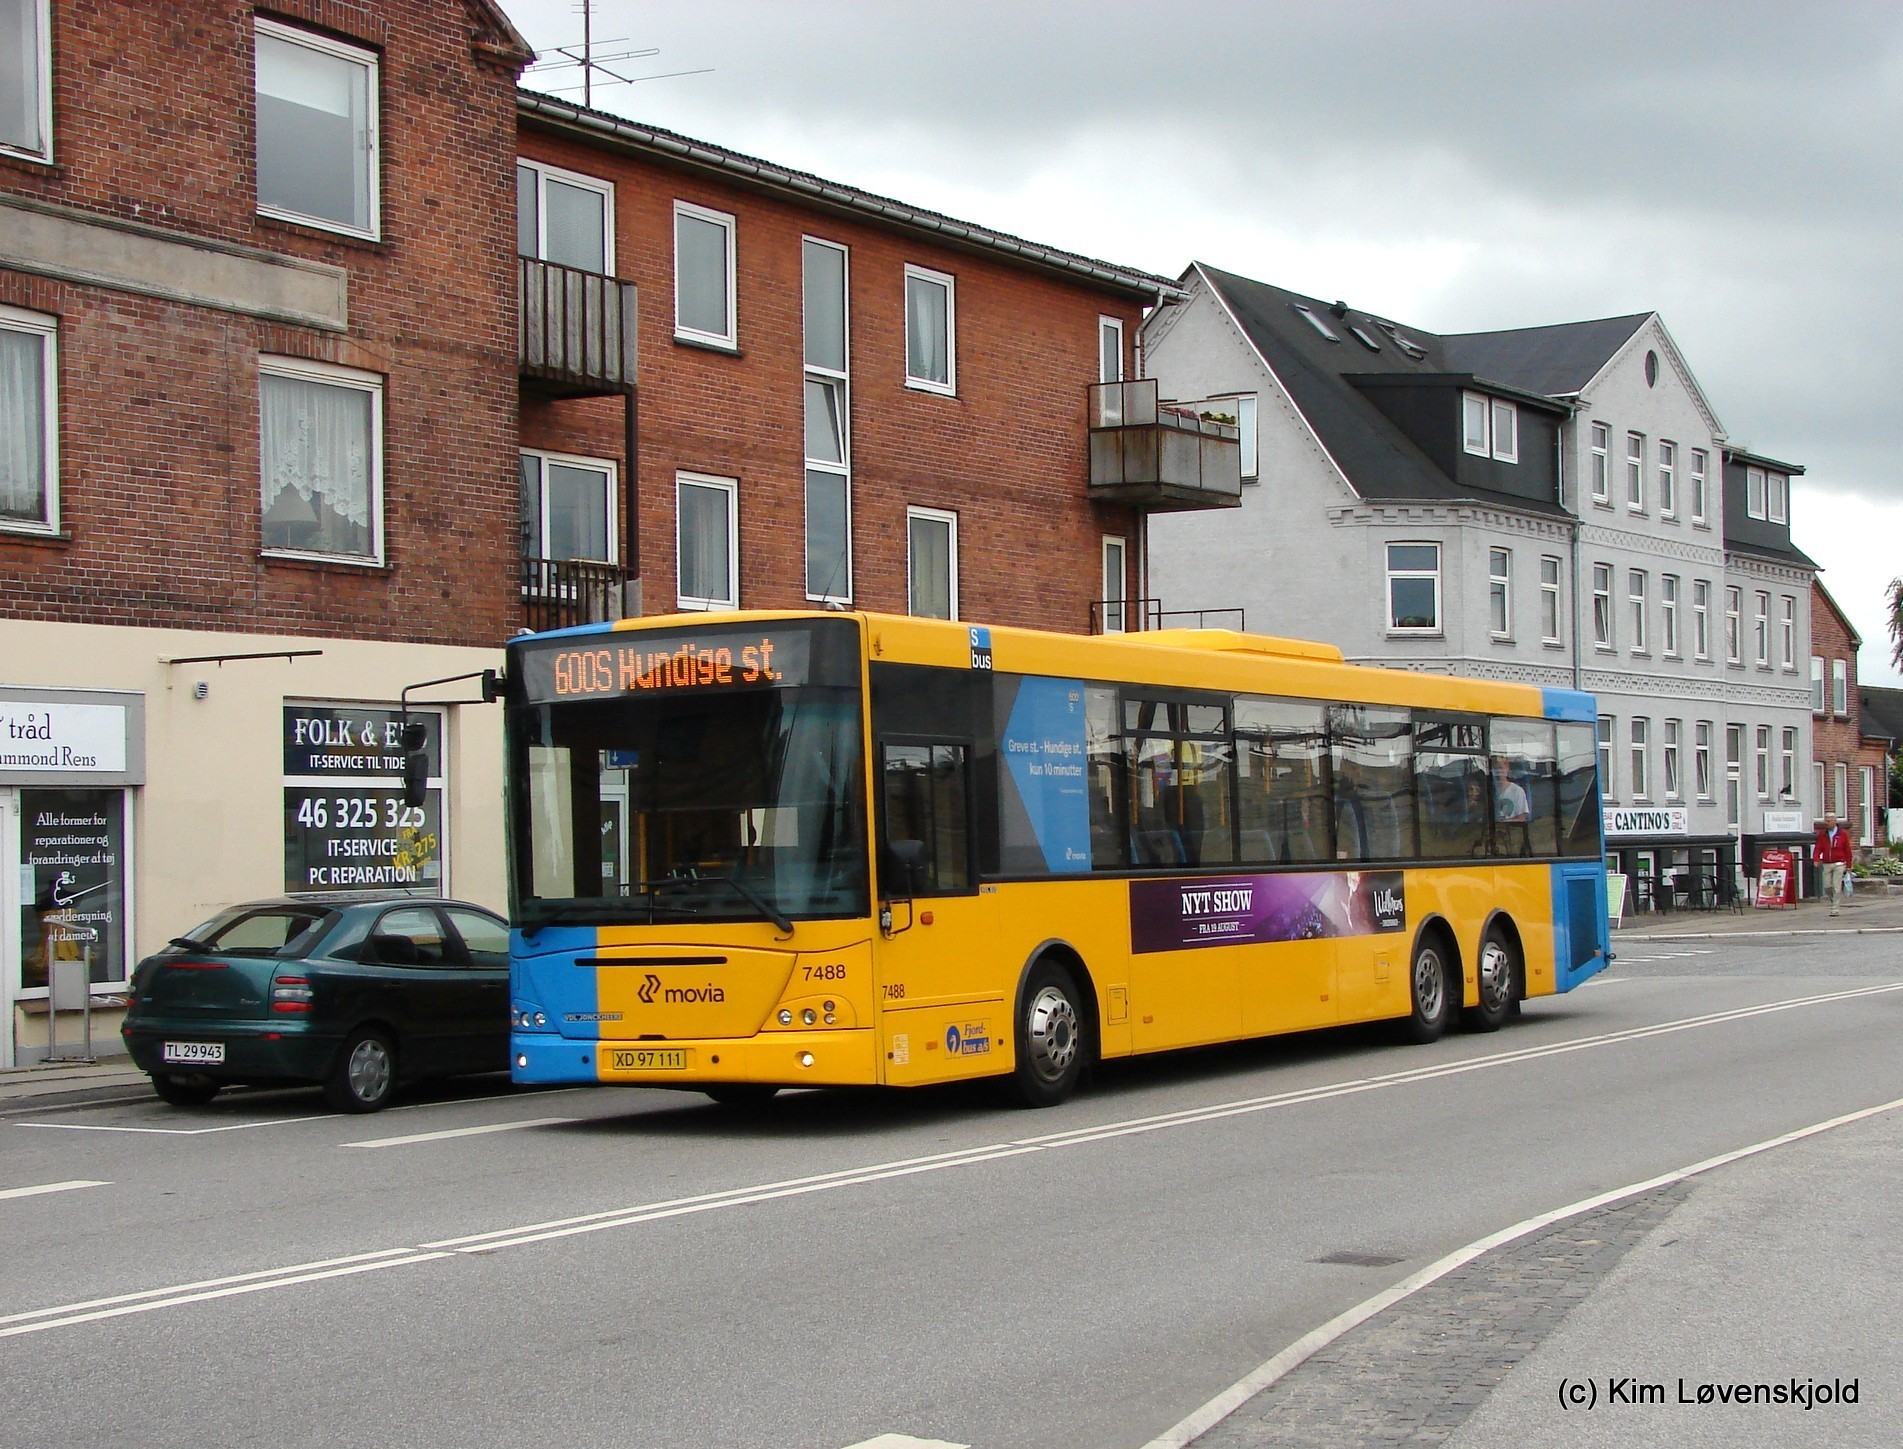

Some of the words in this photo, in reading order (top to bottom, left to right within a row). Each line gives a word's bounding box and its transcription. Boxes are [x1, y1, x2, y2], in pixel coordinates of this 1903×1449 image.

[970, 628, 979, 647] S
[555, 650, 613, 695] 600S
[618, 643, 733, 691] Hundige
[742, 638, 783, 682] st.
[972, 650, 991, 670] bus
[9, 713, 51, 740] tråd
[295, 718, 355, 747] FOLK
[361, 720, 378, 747] &
[62, 746, 96, 767] Rens
[1008, 739, 1029, 753] Greve
[1044, 740, 1072, 758] Hundige
[310, 754, 363, 769] IT-SERVICE
[365, 756, 381, 769] TIL
[1029, 762, 1043, 775] kun
[1044, 762, 1053, 776] 10
[1053, 763, 1082, 777] minutter
[36, 812, 59, 826] Alle
[61, 812, 92, 826] former
[93, 811, 107, 826] for
[298, 798, 328, 828] 46
[335, 798, 378, 828] 325
[1615, 812, 1670, 831] CANTINO'S
[35, 834, 95, 848] reparationer
[96, 834, 109, 847] og
[328, 838, 397, 857] IT-SERVICE
[414, 833, 436, 858] 275
[28, 850, 90, 867] forandringer
[91, 850, 101, 864] af
[102, 852, 115, 866] tøj
[310, 866, 328, 885] PC
[331, 865, 416, 885] REPARATION
[1181, 892, 1211, 915] NYT
[1213, 890, 1253, 913] SHOW
[1198, 923, 1210, 934] FRA
[1218, 921, 1240, 932] AUGUST
[802, 964, 847, 981] 7488
[665, 983, 725, 1003] movia
[882, 984, 905, 999] 7488
[166, 1044, 181, 1057] TL
[184, 1044, 198, 1058] 29
[200, 1045, 222, 1059] 943
[962, 1040, 976, 1054] bus
[616, 1053, 634, 1067] XD
[638, 1053, 654, 1067] 97
[660, 1053, 680, 1066] 111
